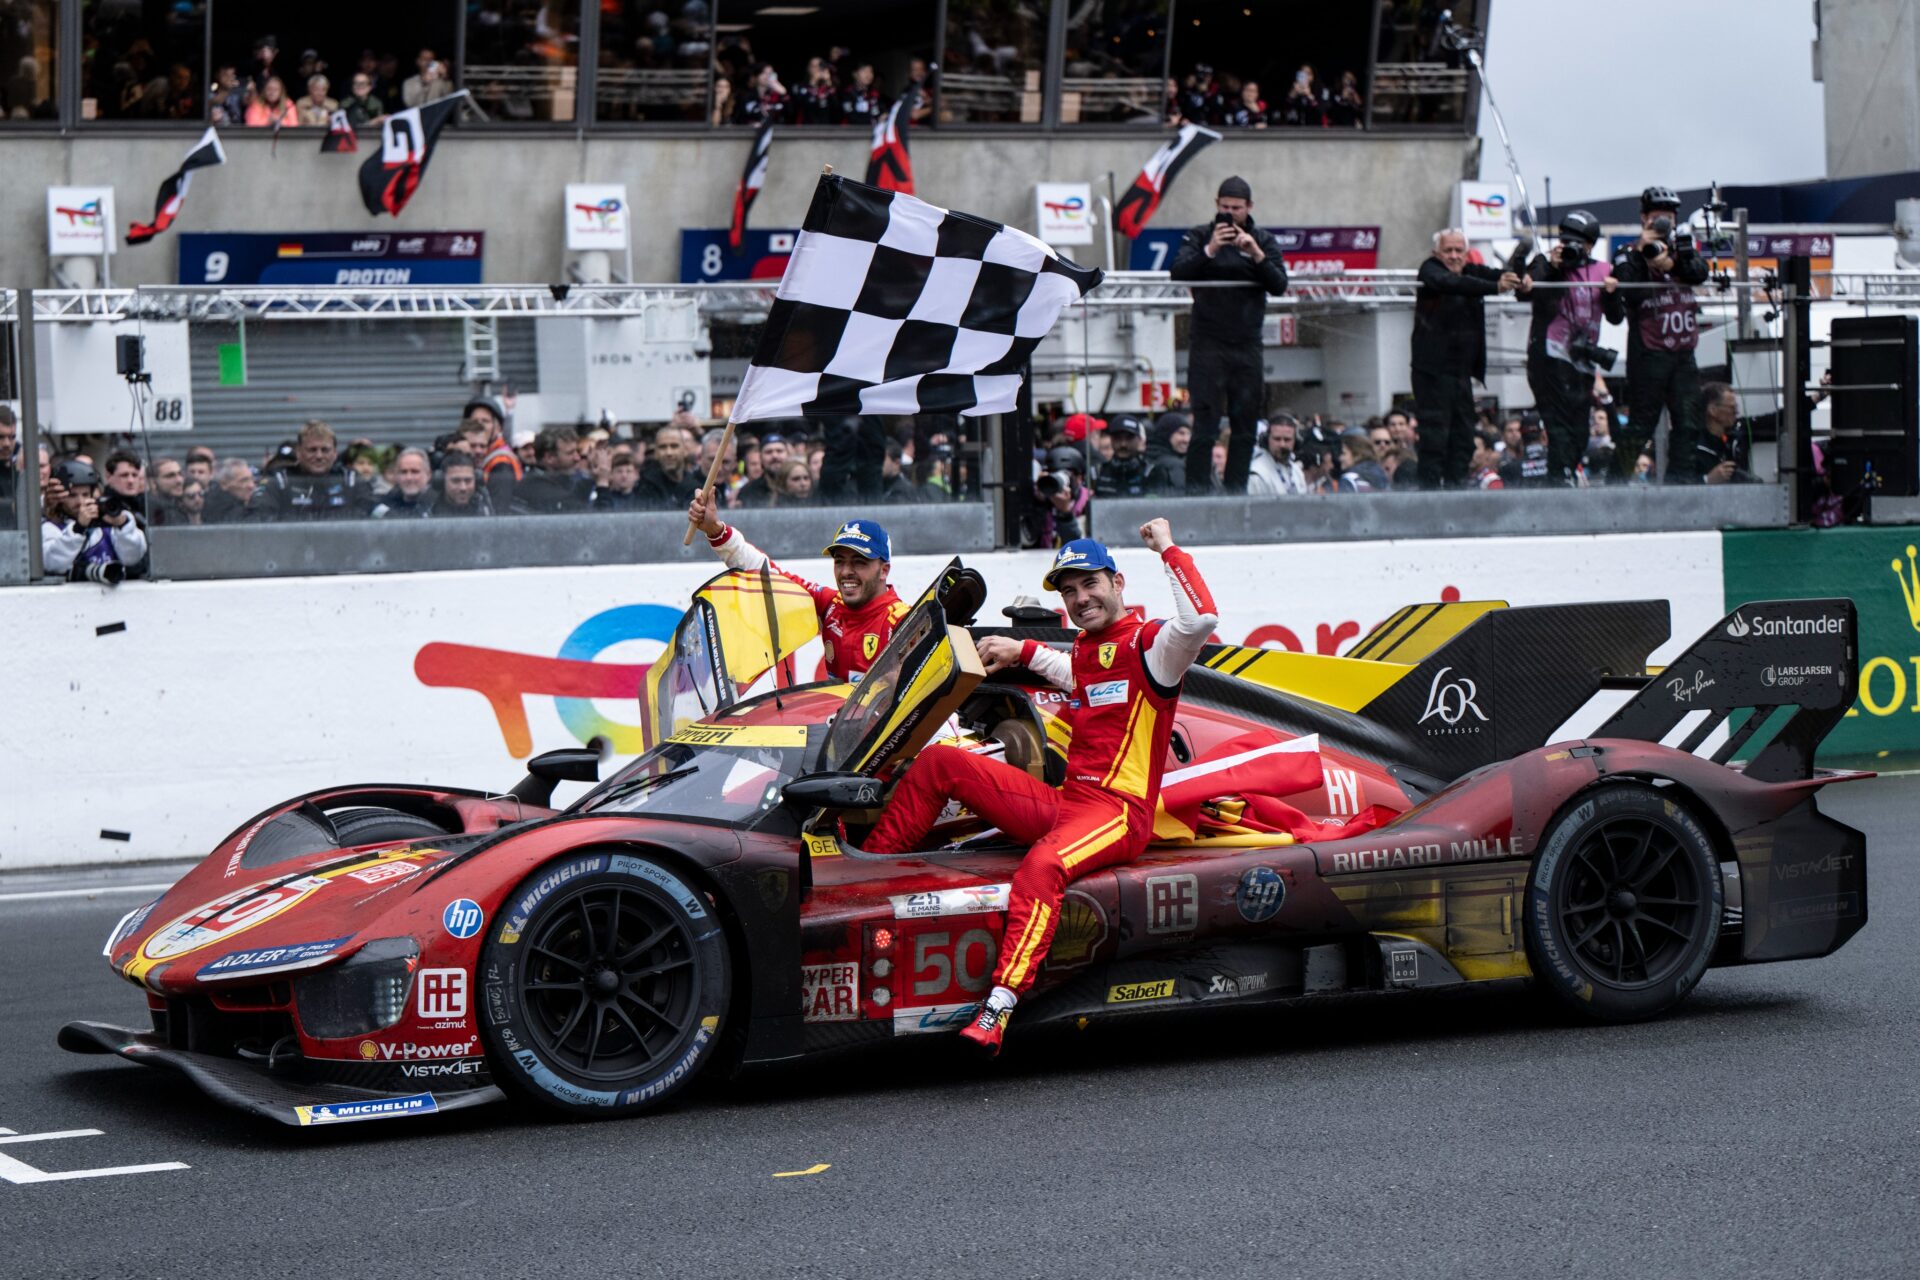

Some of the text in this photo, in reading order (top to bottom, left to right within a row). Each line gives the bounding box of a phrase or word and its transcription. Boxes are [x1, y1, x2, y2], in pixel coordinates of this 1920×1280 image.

[205, 251, 230, 282] 9
[702, 244, 722, 276] 8
[1149, 242, 1168, 271] 7
[335, 268, 411, 284] PROTON
[1659, 311, 1696, 335] 706
[592, 353, 632, 365] IRON
[155, 399, 182, 421] 88
[1175, 566, 1188, 583] MILLE
[1752, 614, 1846, 636] Santander
[1777, 665, 1832, 676] LARS LARSEN
[1777, 676, 1805, 686] GROUP
[1427, 727, 1480, 737] ESPRESSO
[1322, 769, 1359, 815] HY
[1578, 804, 1591, 820] W
[224, 816, 271, 880] RICHARD MILLE
[1332, 837, 1524, 873] RICHARD MILLE
[617, 860, 672, 885] PILOT SPORT
[521, 857, 600, 913] MICHELIN
[684, 898, 702, 914] W
[448, 899, 479, 937] hp
[1536, 899, 1572, 987] MICHELIN
[210, 949, 286, 969] ADLER
[913, 928, 997, 997] 50
[1113, 980, 1168, 1001] Sabelt
[434, 1018, 467, 1029] azimut
[379, 1041, 474, 1060] V-Power
[400, 1059, 483, 1077] VISTAJET
[520, 1054, 539, 1070] W
[626, 1046, 700, 1104] MICHELIN
[552, 1083, 609, 1105] PILOT SPORT
[337, 1098, 423, 1115] MICHELIN
